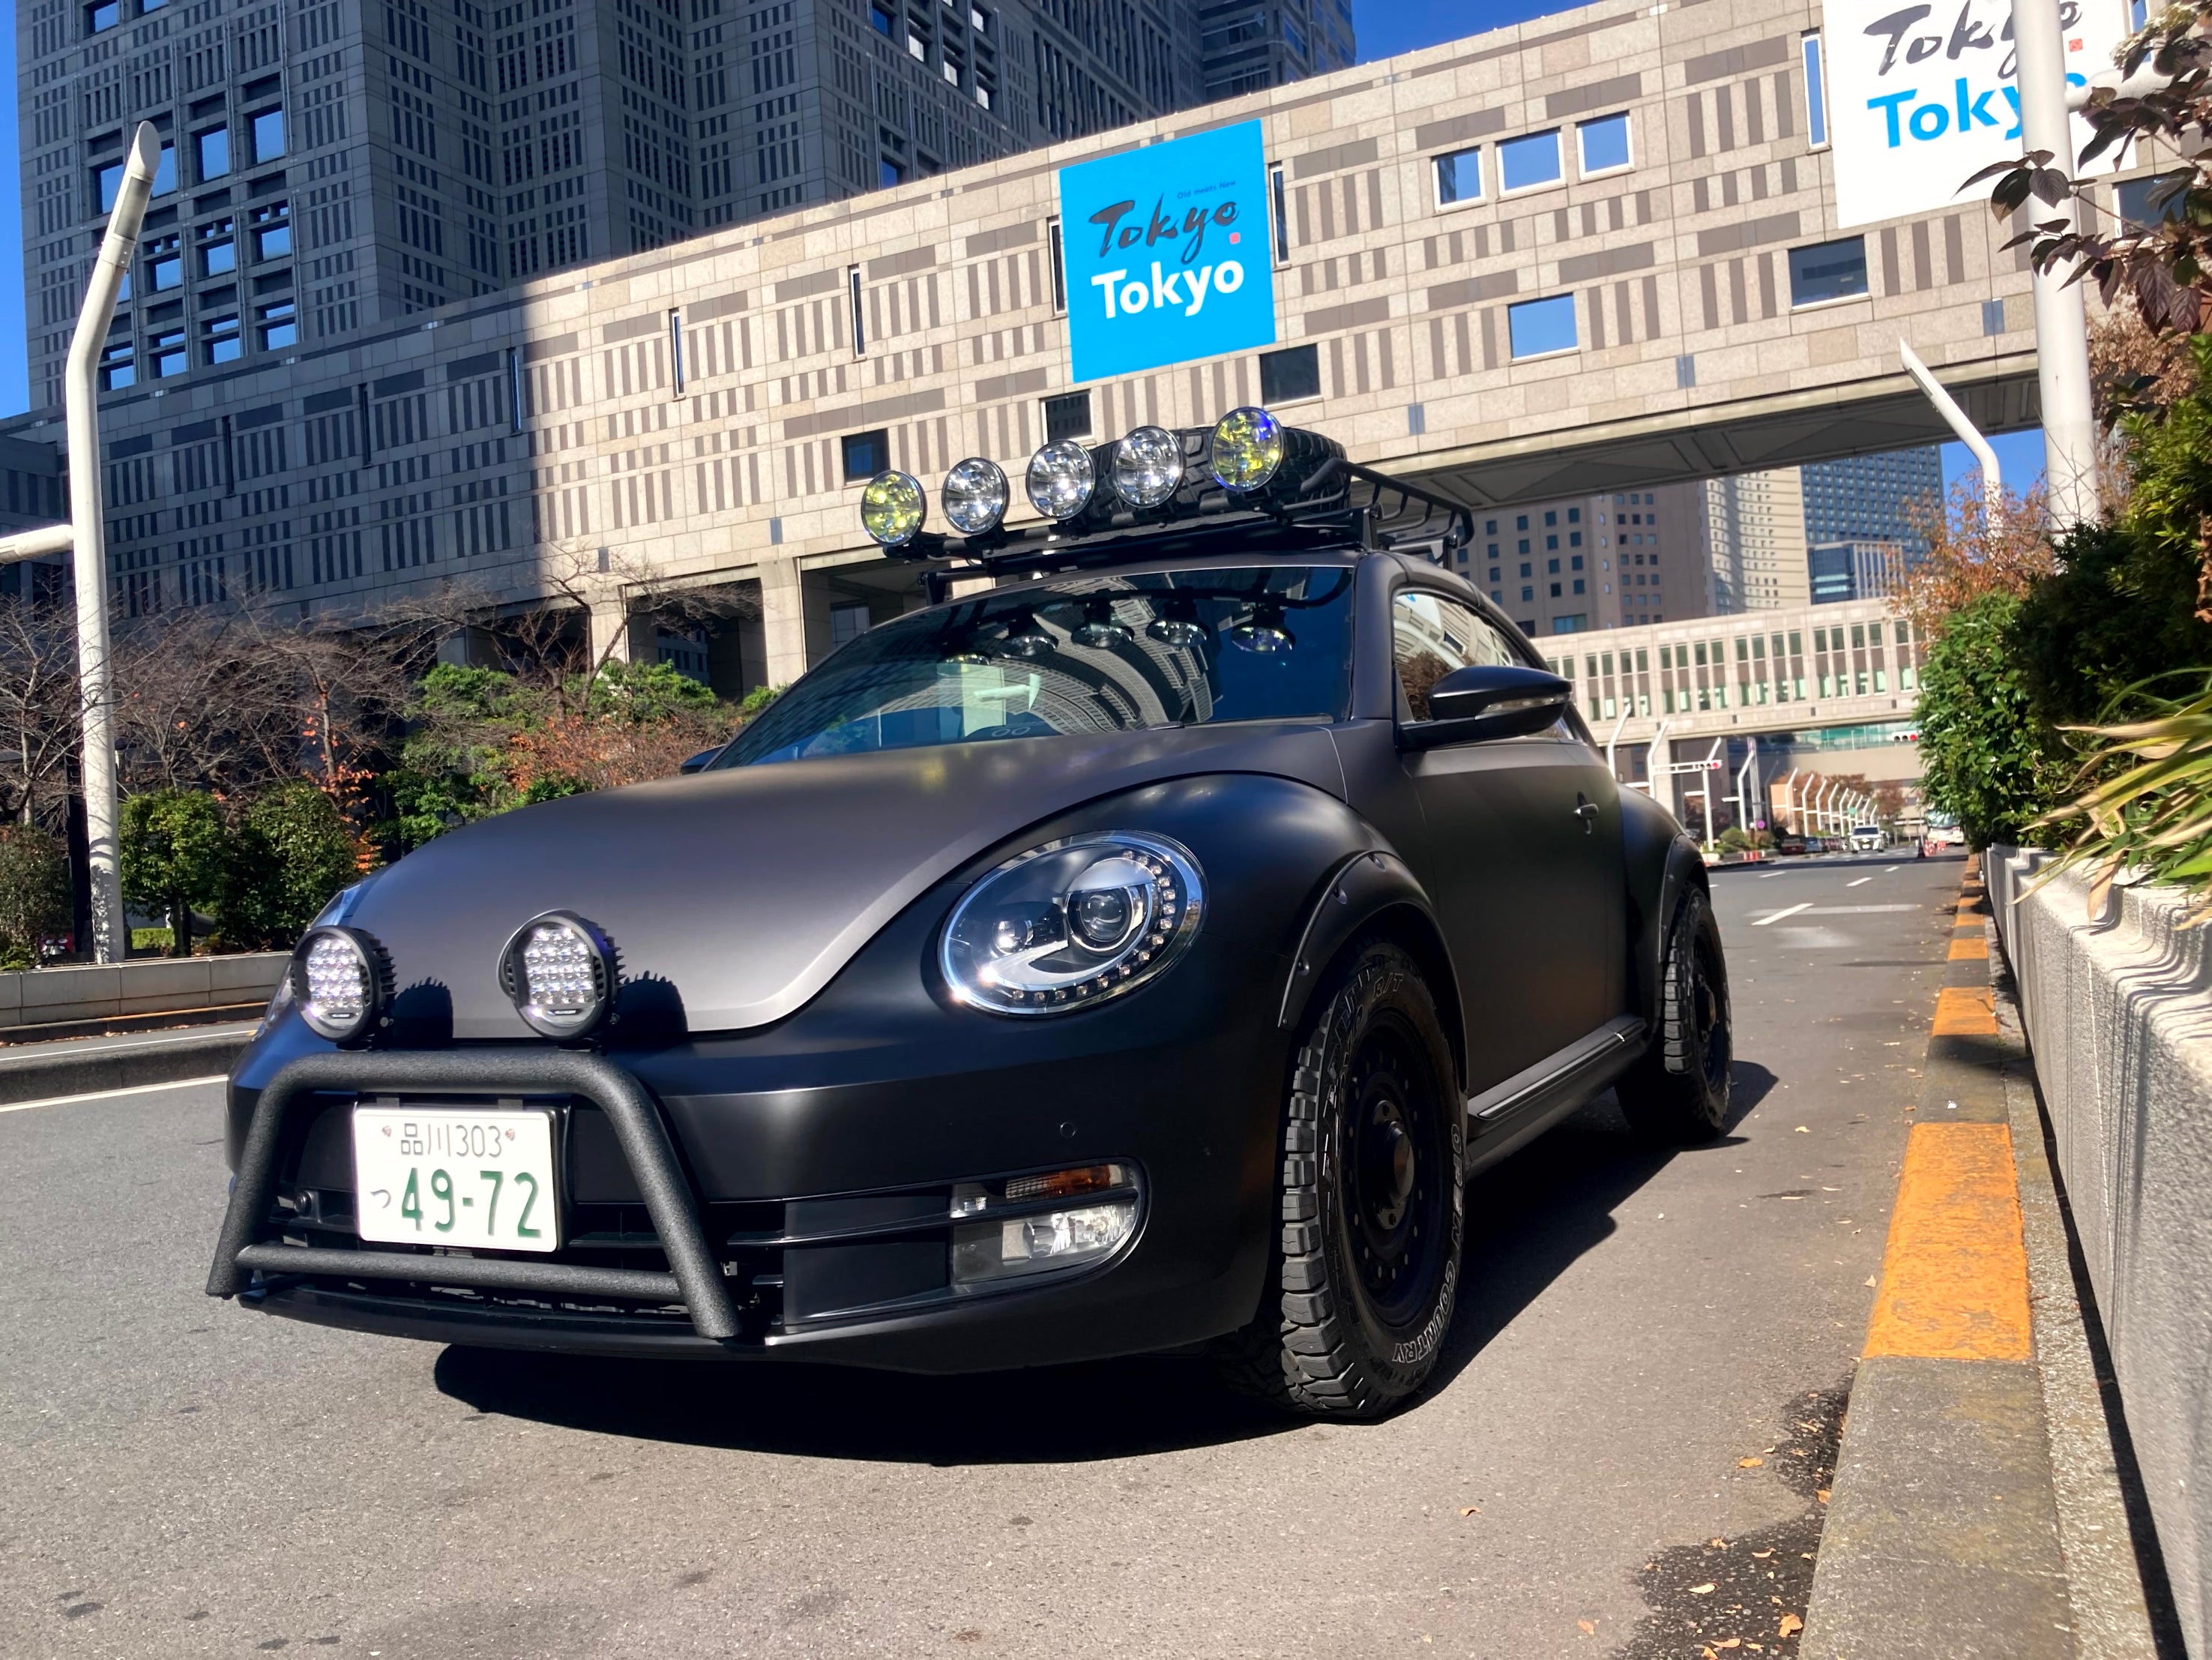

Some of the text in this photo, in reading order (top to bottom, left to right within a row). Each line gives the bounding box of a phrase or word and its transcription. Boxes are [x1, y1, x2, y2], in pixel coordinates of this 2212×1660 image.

[1177, 180, 1236, 199] Old meets New
[1088, 192, 1240, 265] Tokyo
[1091, 260, 1244, 319] Tokyo
[402, 1167, 542, 1239] 49-72
[1392, 1124, 1464, 1363] OPEN COUNTRY
